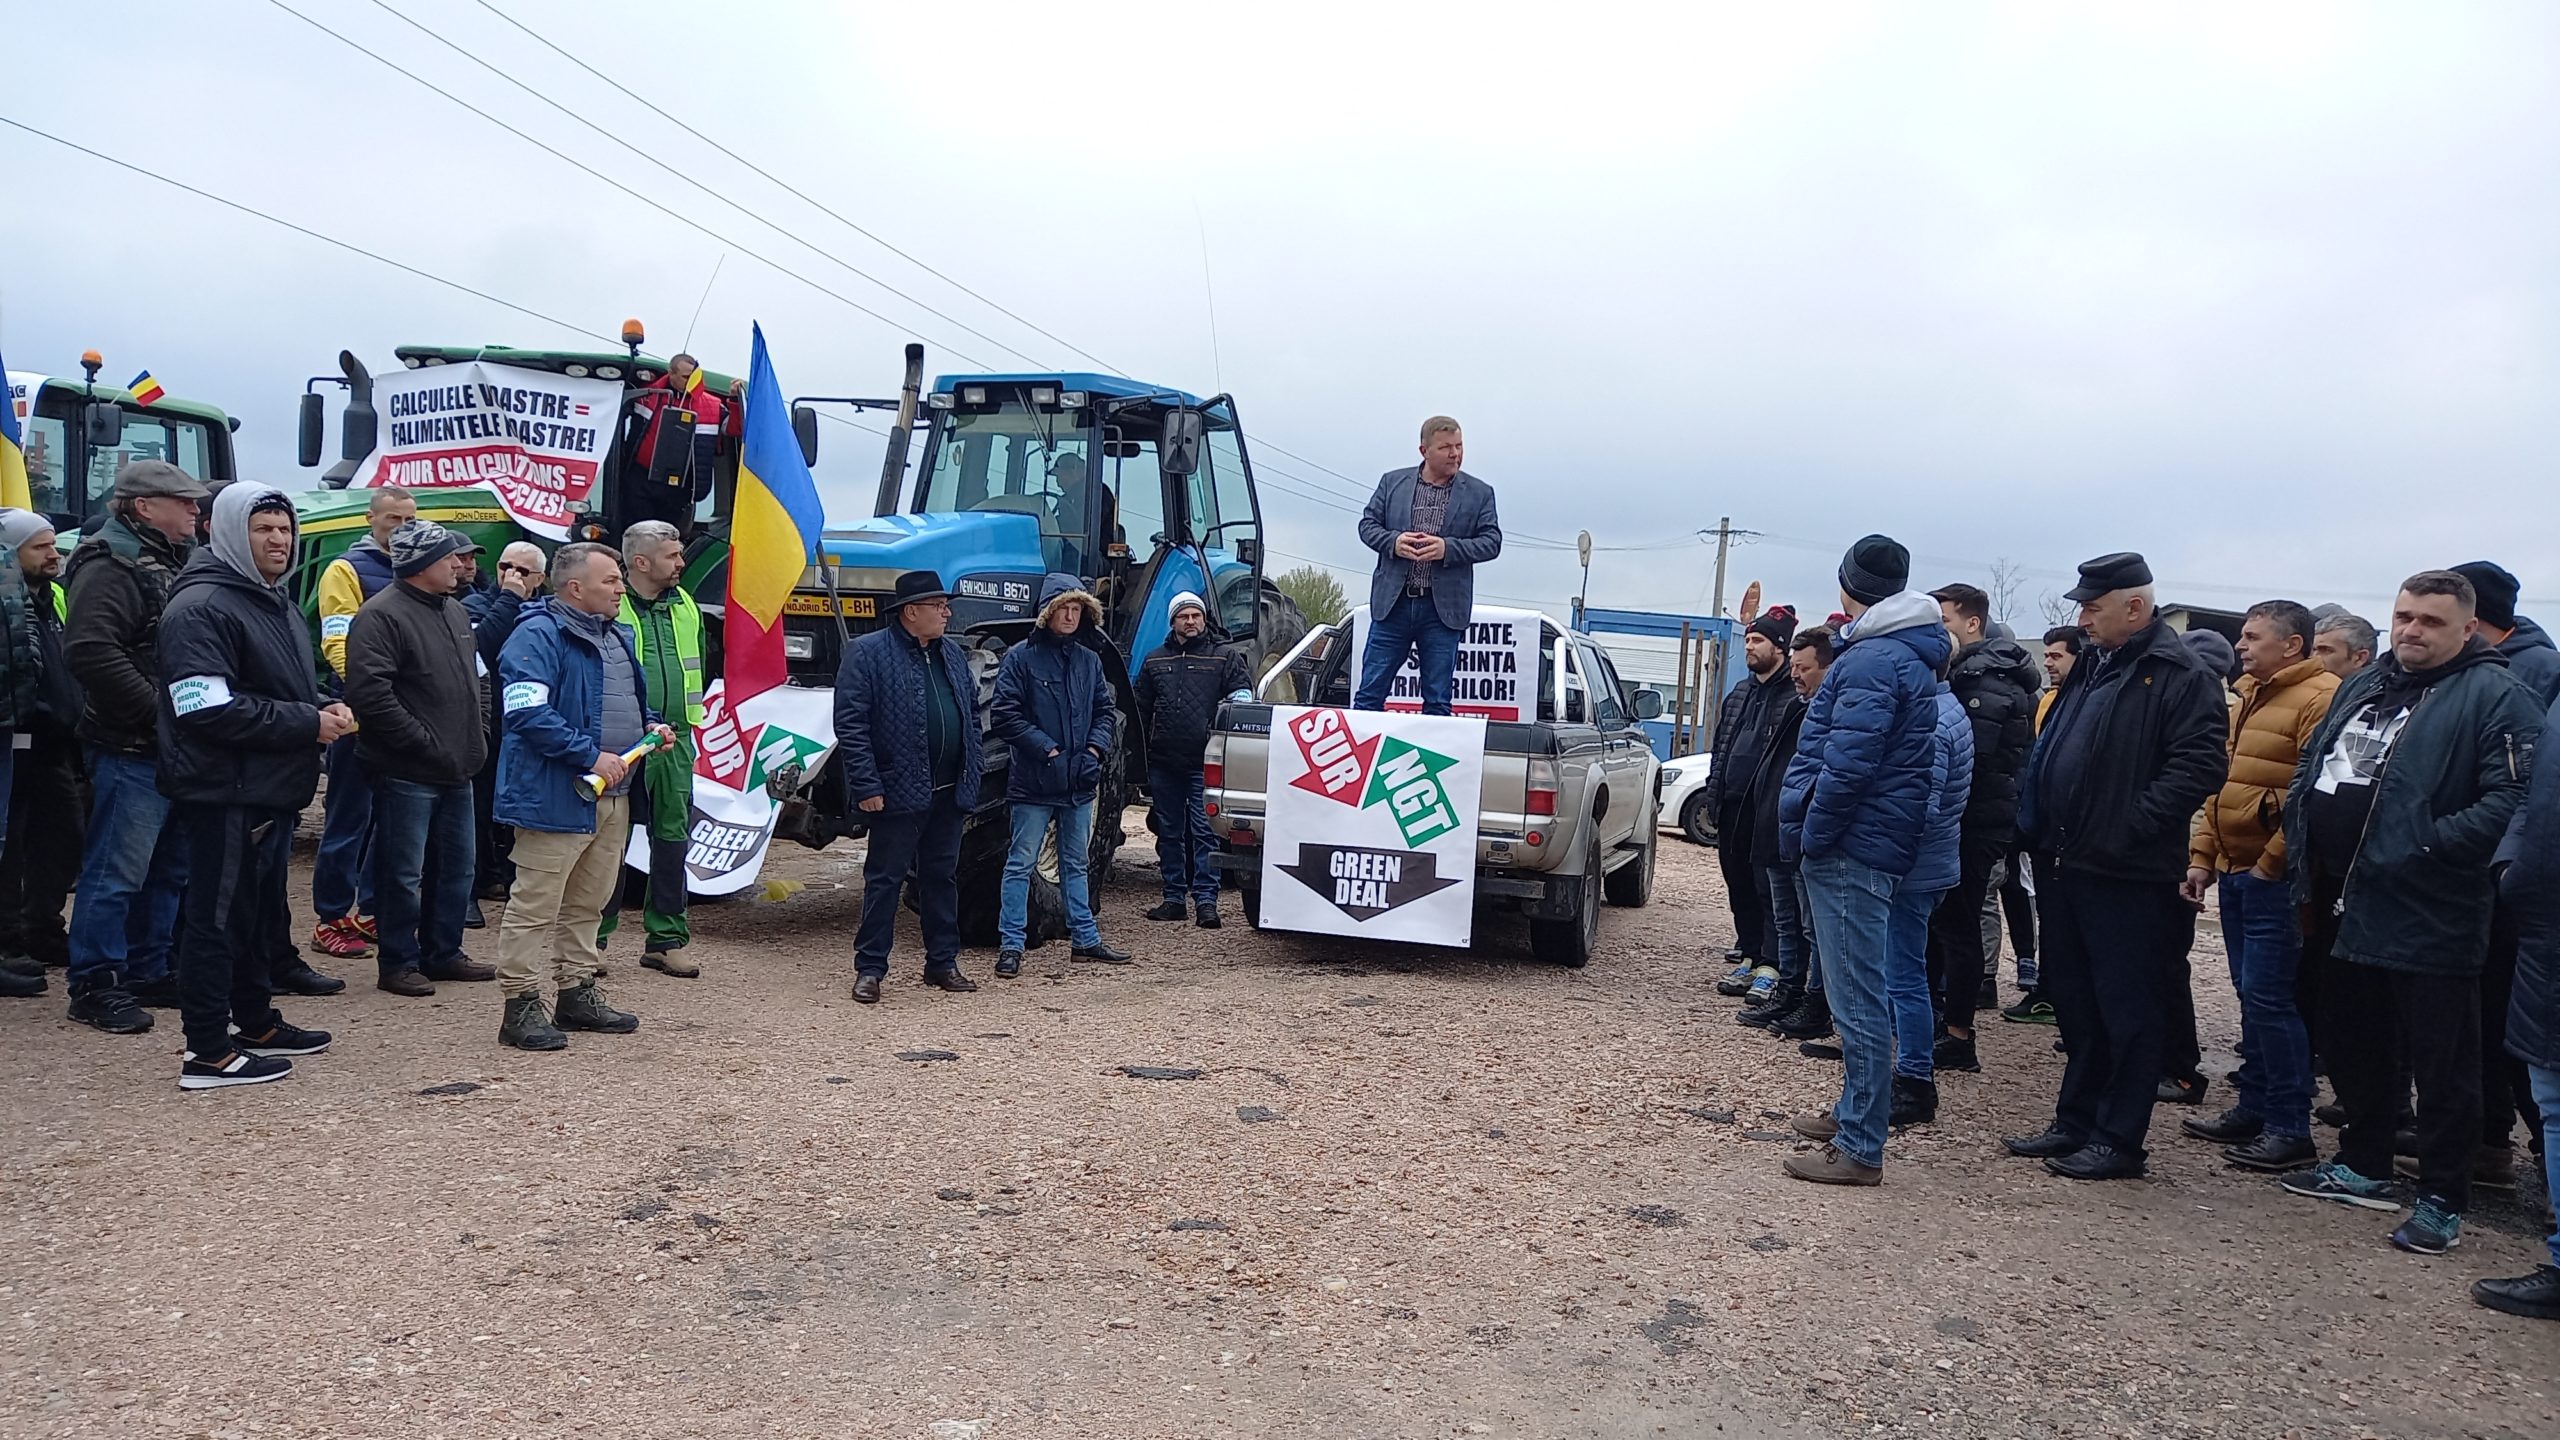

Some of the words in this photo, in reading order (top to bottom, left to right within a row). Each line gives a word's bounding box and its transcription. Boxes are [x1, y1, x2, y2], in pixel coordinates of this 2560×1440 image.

[390, 384, 477, 418] CALCULELE
[391, 412, 502, 448] FALIMENTELE
[388, 457, 435, 487] YOUR
[453, 510, 474, 521] JOHN
[474, 510, 498, 521] DEERE
[960, 579, 973, 594] NEW
[973, 580, 999, 596] HOLLAND
[1003, 581, 1030, 599] 8670
[1003, 604, 1020, 613] FORD
[1298, 709, 1362, 795] SUR
[1376, 748, 1454, 839] NGT
[690, 819, 761, 852] GREEN
[686, 845, 740, 872] DEAL
[1329, 850, 1402, 883] GREEN
[1335, 879, 1390, 909] DEAL
